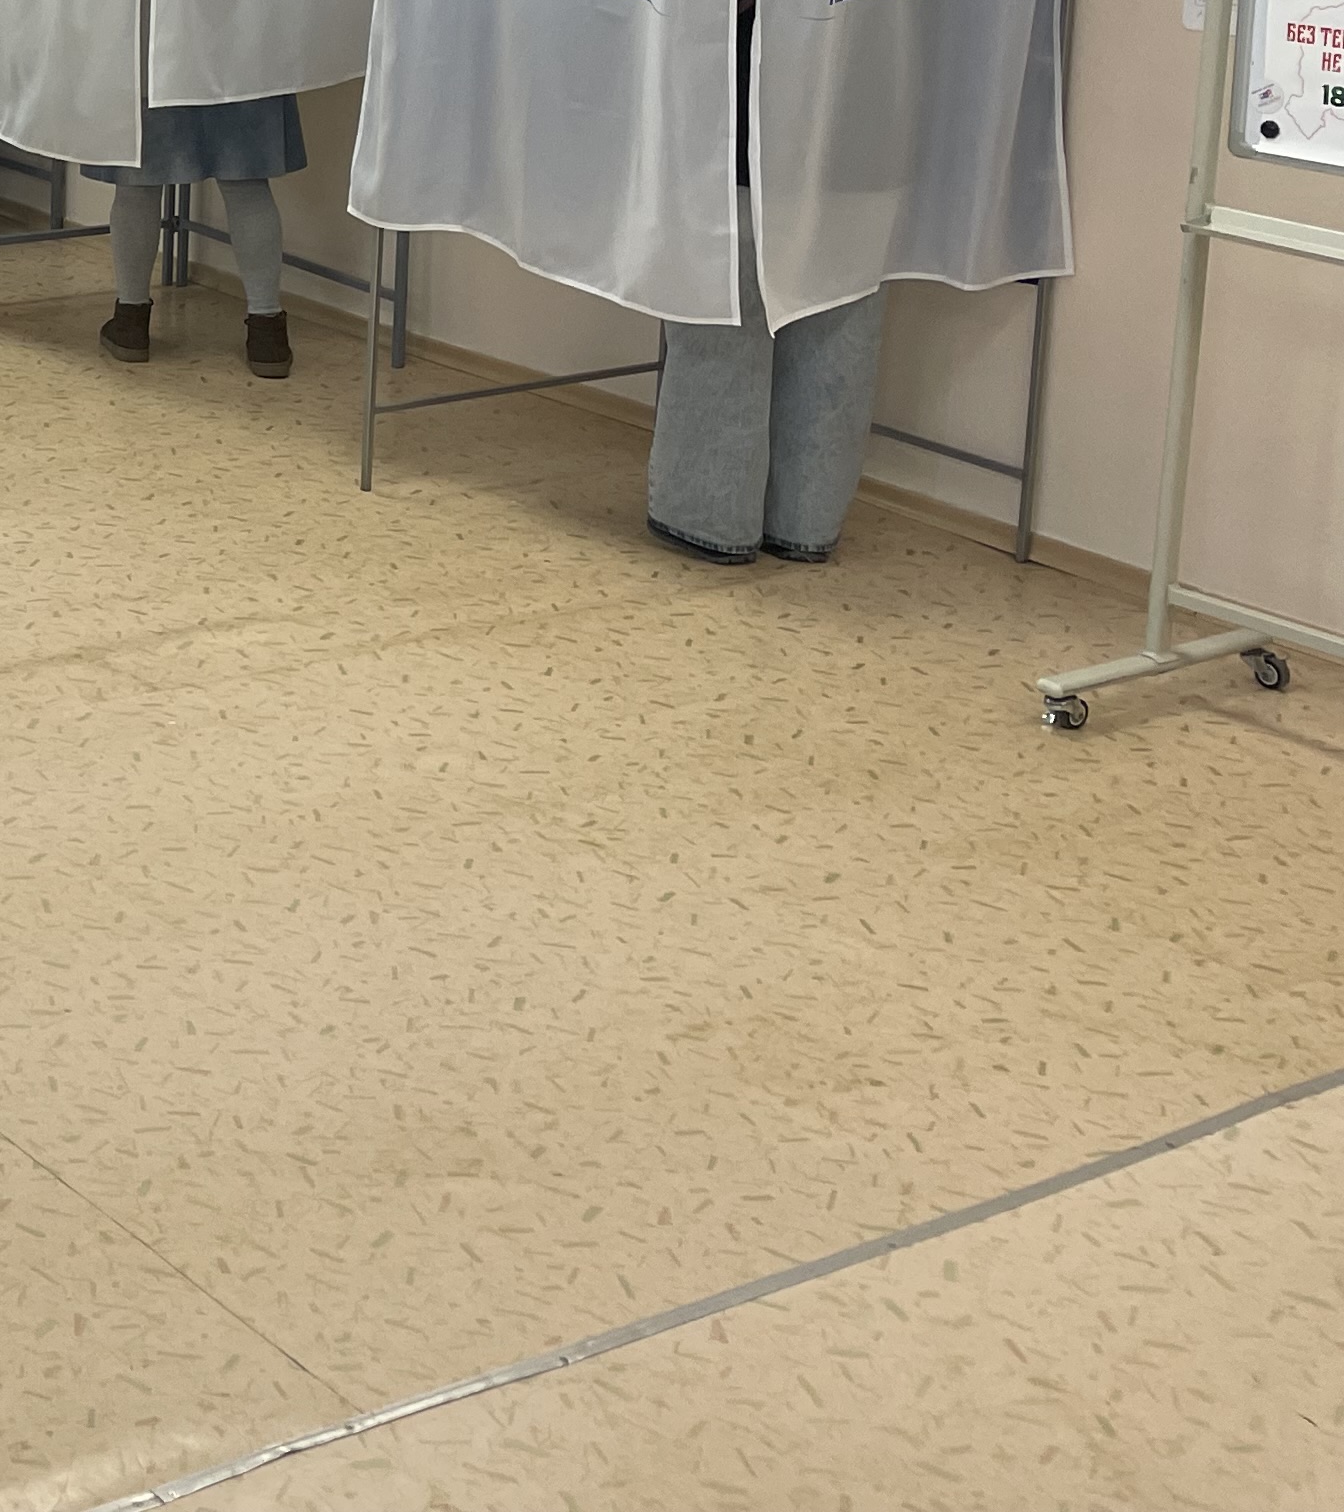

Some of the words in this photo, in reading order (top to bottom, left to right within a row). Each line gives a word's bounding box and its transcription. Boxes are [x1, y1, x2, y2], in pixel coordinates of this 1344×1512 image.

[1287, 23, 1316, 45] БЕЗ
[1320, 27, 1344, 49] ТЕ
[1321, 51, 1341, 73] НЕ
